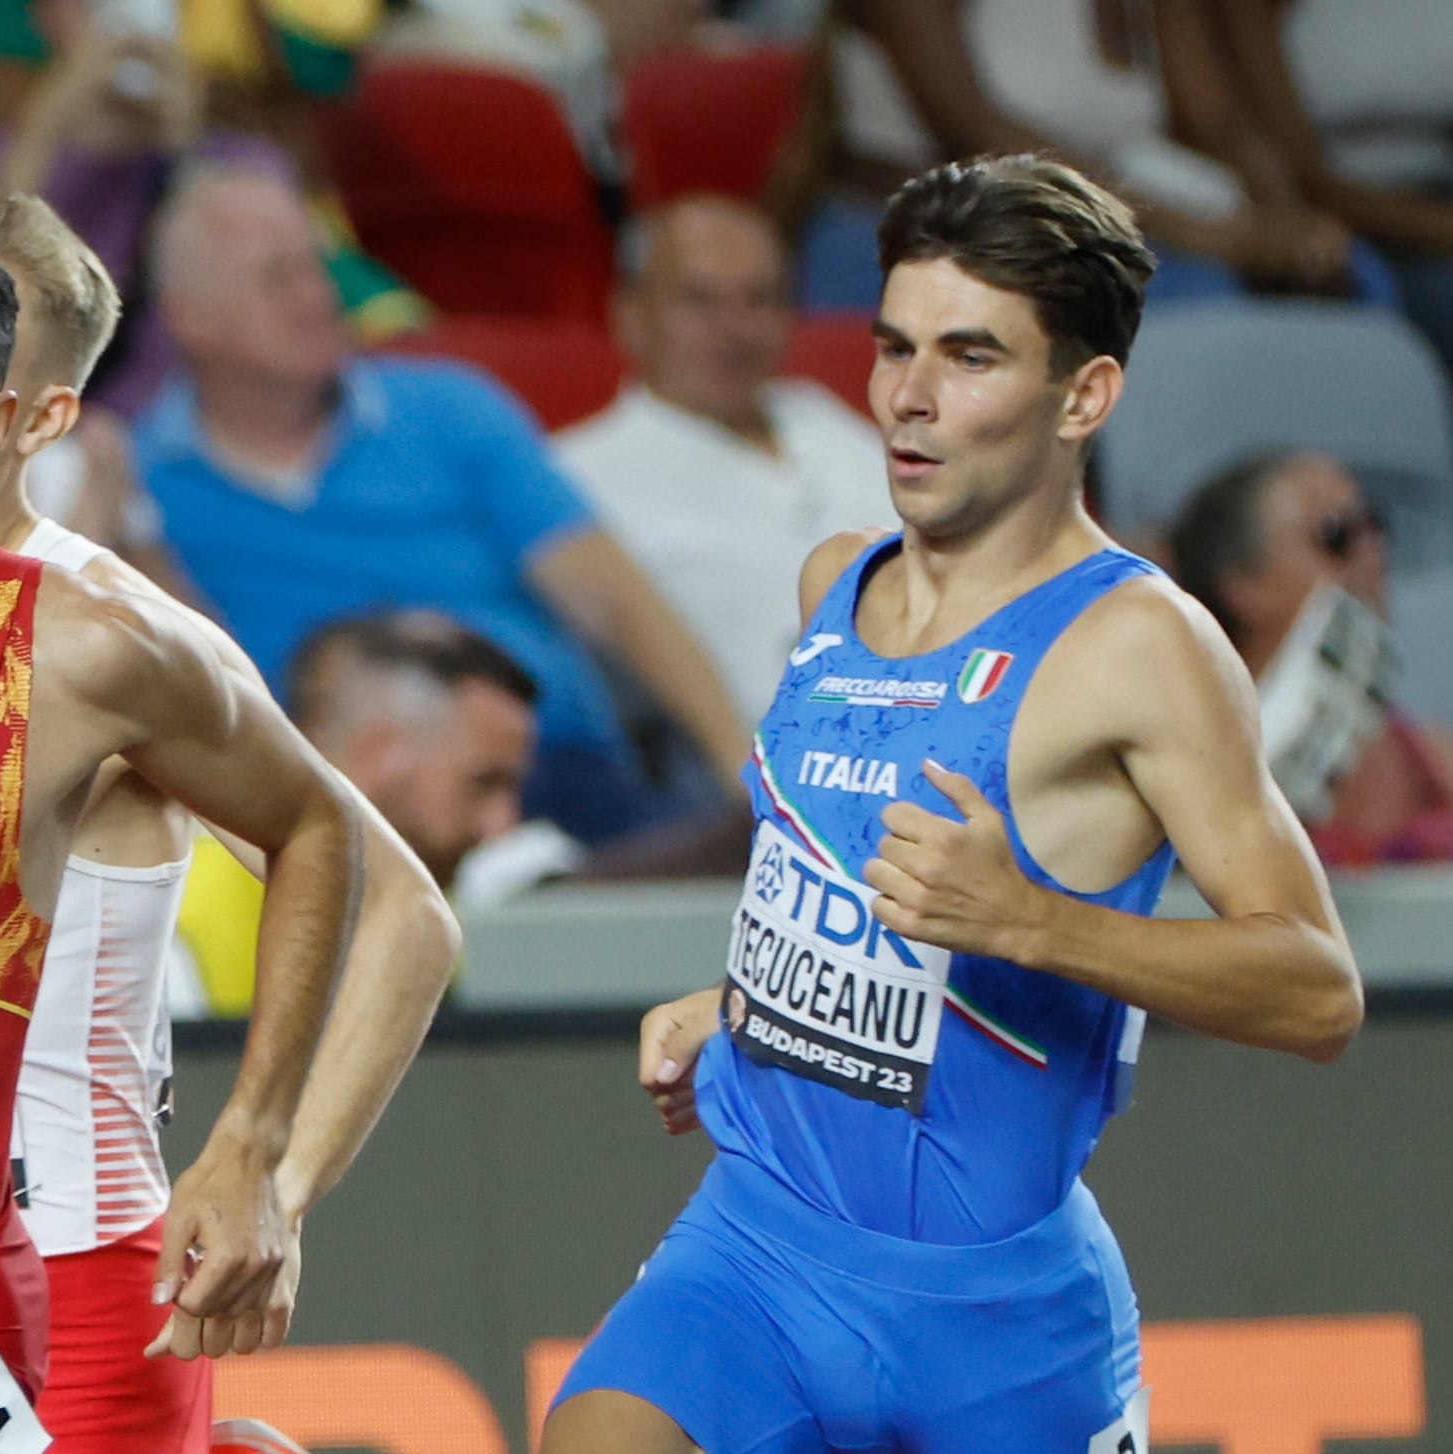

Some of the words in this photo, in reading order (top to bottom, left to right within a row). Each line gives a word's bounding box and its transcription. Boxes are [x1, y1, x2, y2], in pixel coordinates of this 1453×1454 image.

[814, 676, 948, 698] FRECCIAROSSA
[797, 750, 898, 798] ITALIA
[789, 856, 925, 970] TDK
[733, 909, 927, 1049] TECUCEANU
[746, 1014, 877, 1083] BUDAPEST
[877, 1067, 913, 1093] 23
